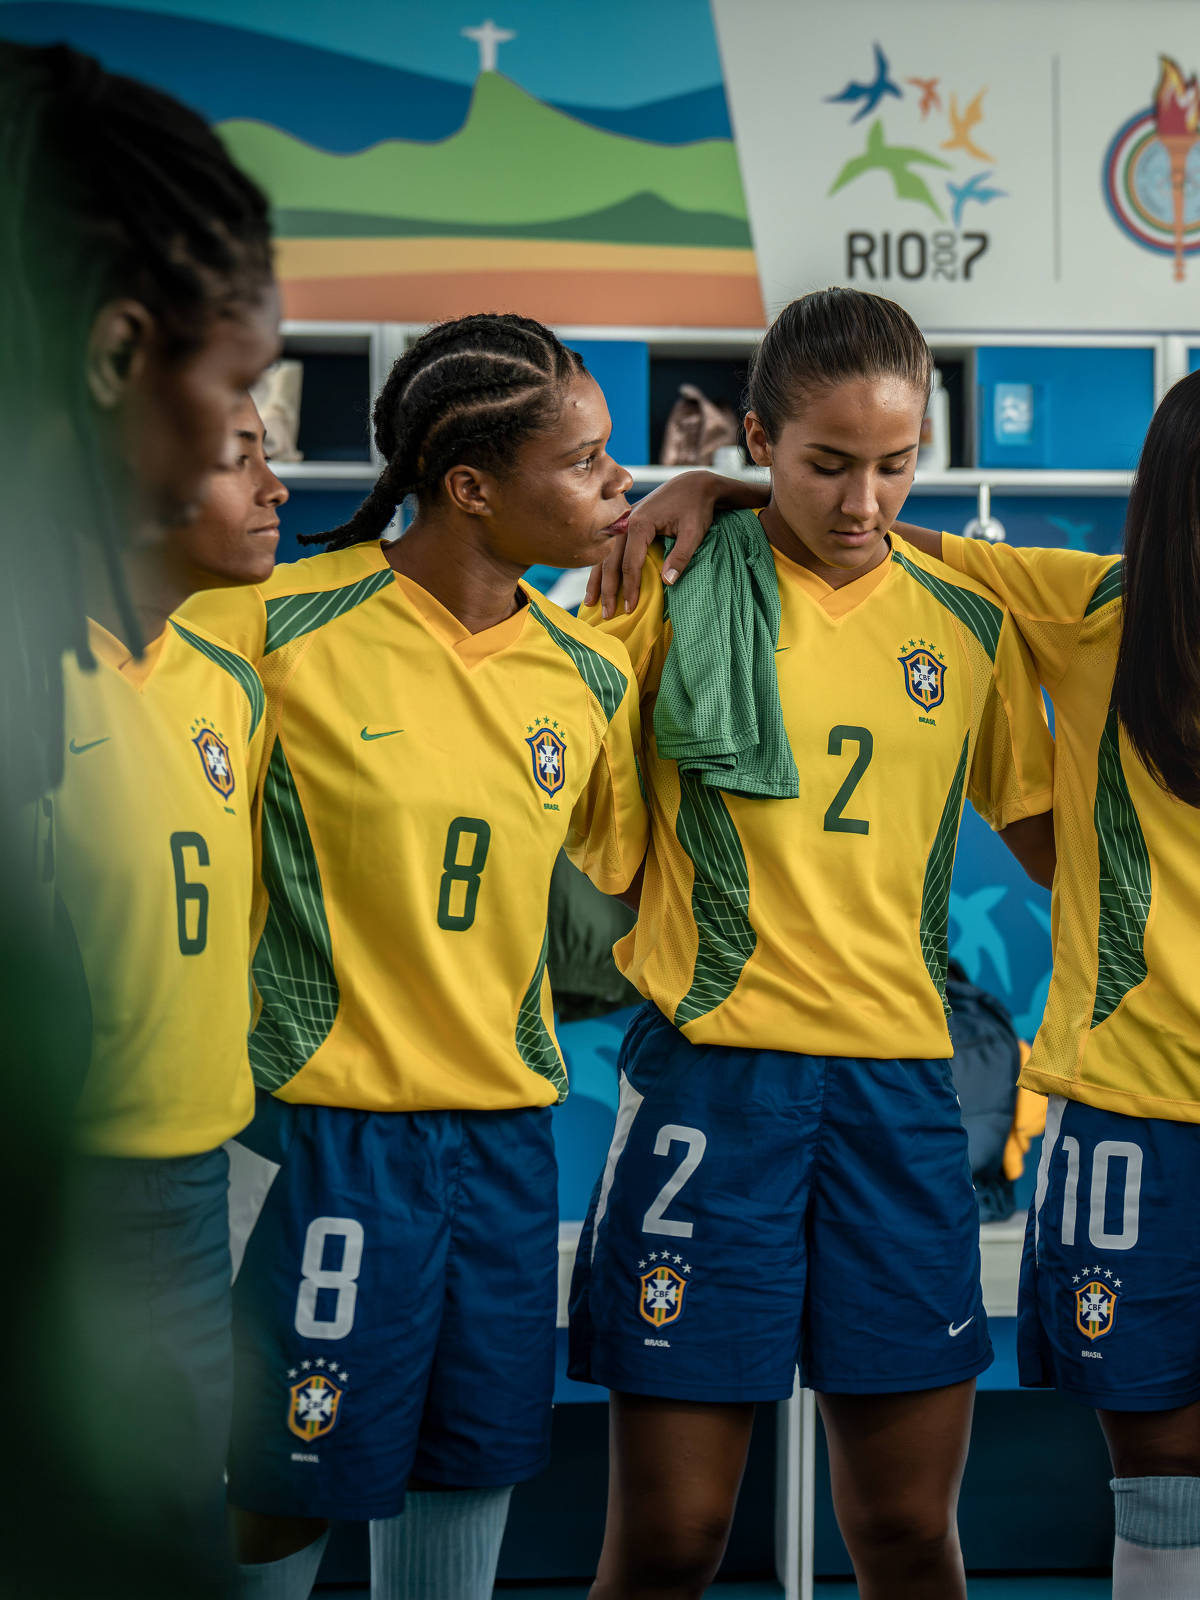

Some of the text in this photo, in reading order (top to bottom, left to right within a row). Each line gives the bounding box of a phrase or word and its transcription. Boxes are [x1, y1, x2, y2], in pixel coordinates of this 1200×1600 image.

[918, 673, 931, 682] CBF
[824, 725, 873, 835] 2
[170, 832, 209, 955] 6
[438, 817, 490, 931] 8
[642, 1125, 706, 1237] 2
[1062, 1136, 1143, 1250] 10
[295, 1218, 364, 1340] 8
[653, 1290, 671, 1298] CBF
[1087, 1303, 1103, 1312] CBF
[644, 1338, 671, 1348] BRASIL
[1081, 1350, 1104, 1360] BRASIL
